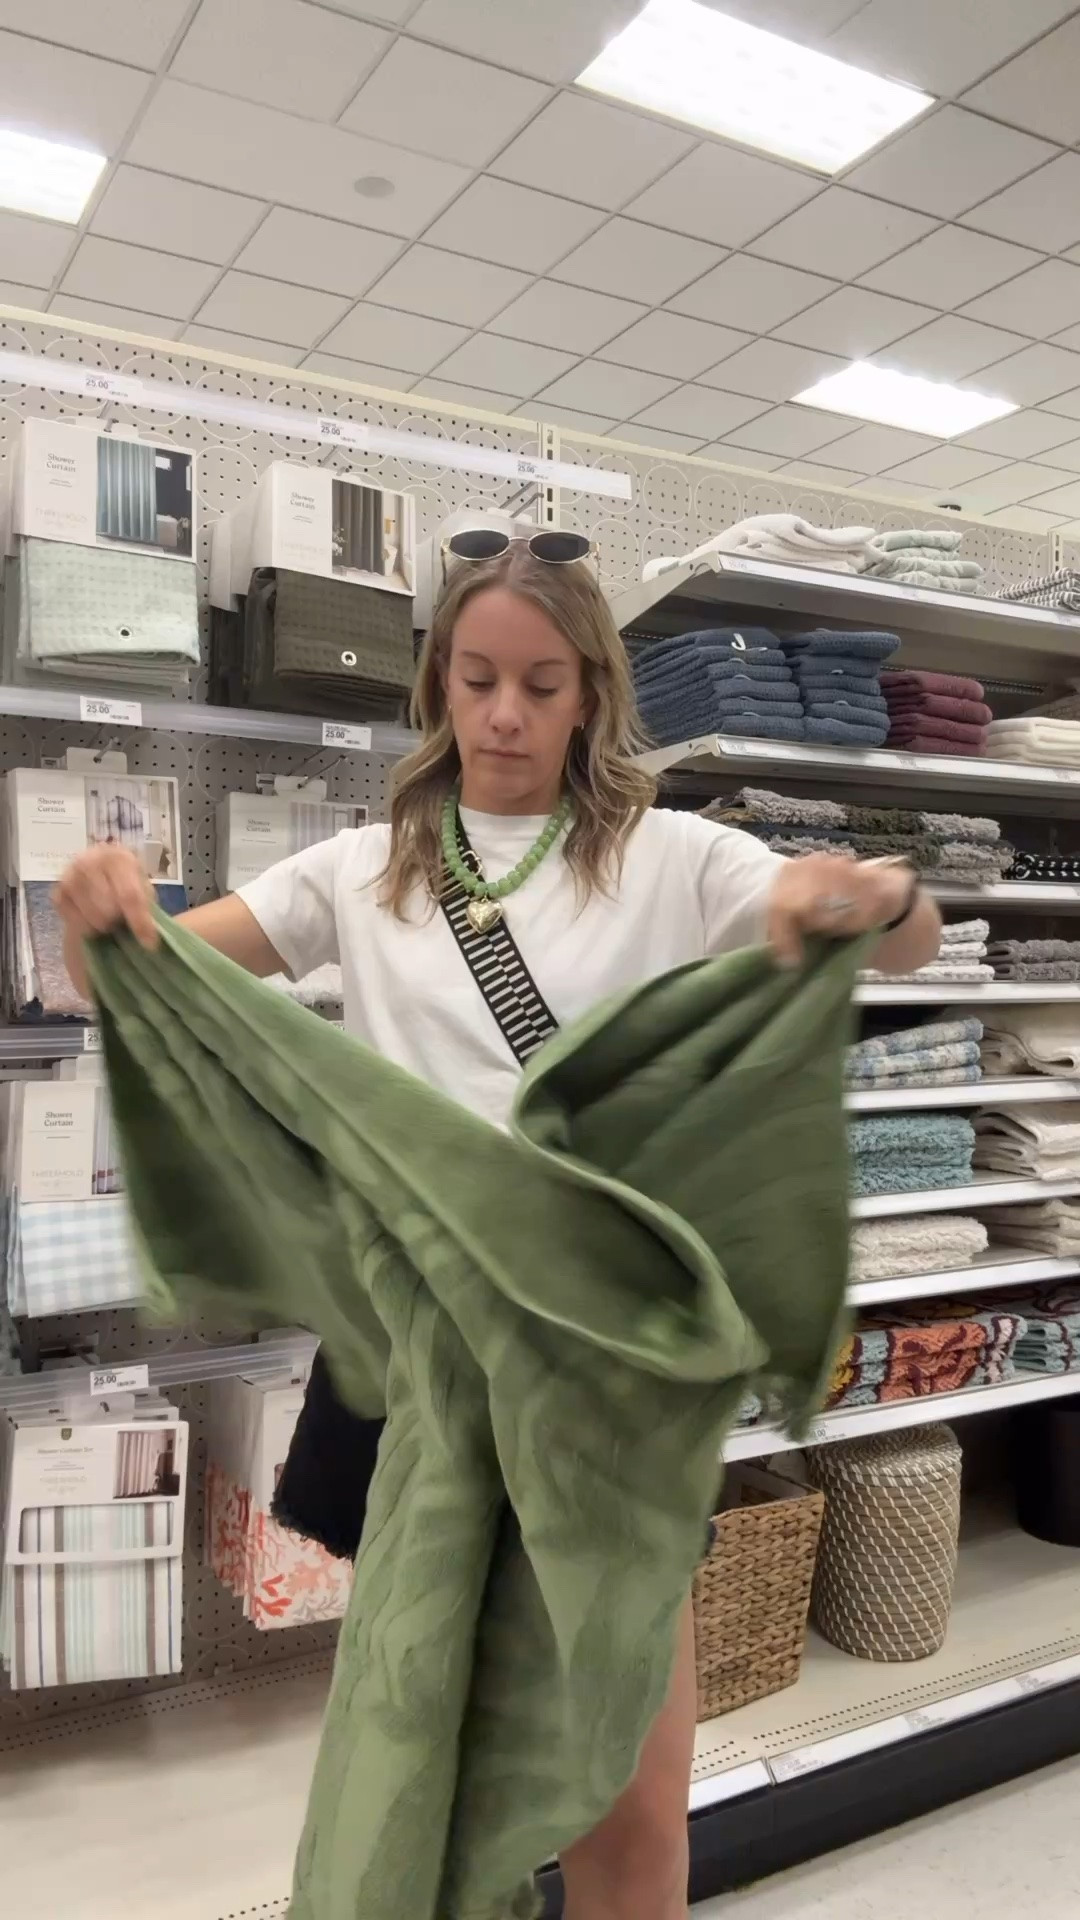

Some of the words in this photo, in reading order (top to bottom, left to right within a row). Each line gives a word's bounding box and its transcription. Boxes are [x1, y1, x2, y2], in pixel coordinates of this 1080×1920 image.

[86, 378, 109, 389] 25.00
[321, 425, 341, 436] 25.00
[47, 453, 75, 465] Shower
[46, 461, 76, 473] Curtain
[86, 704, 110, 714] 25.00
[325, 730, 345, 739] 25.00
[37, 805, 66, 813] Curtain
[45, 1111, 73, 1119] Shower
[44, 1119, 74, 1127] Curtain
[93, 1375, 117, 1385] 25.00
